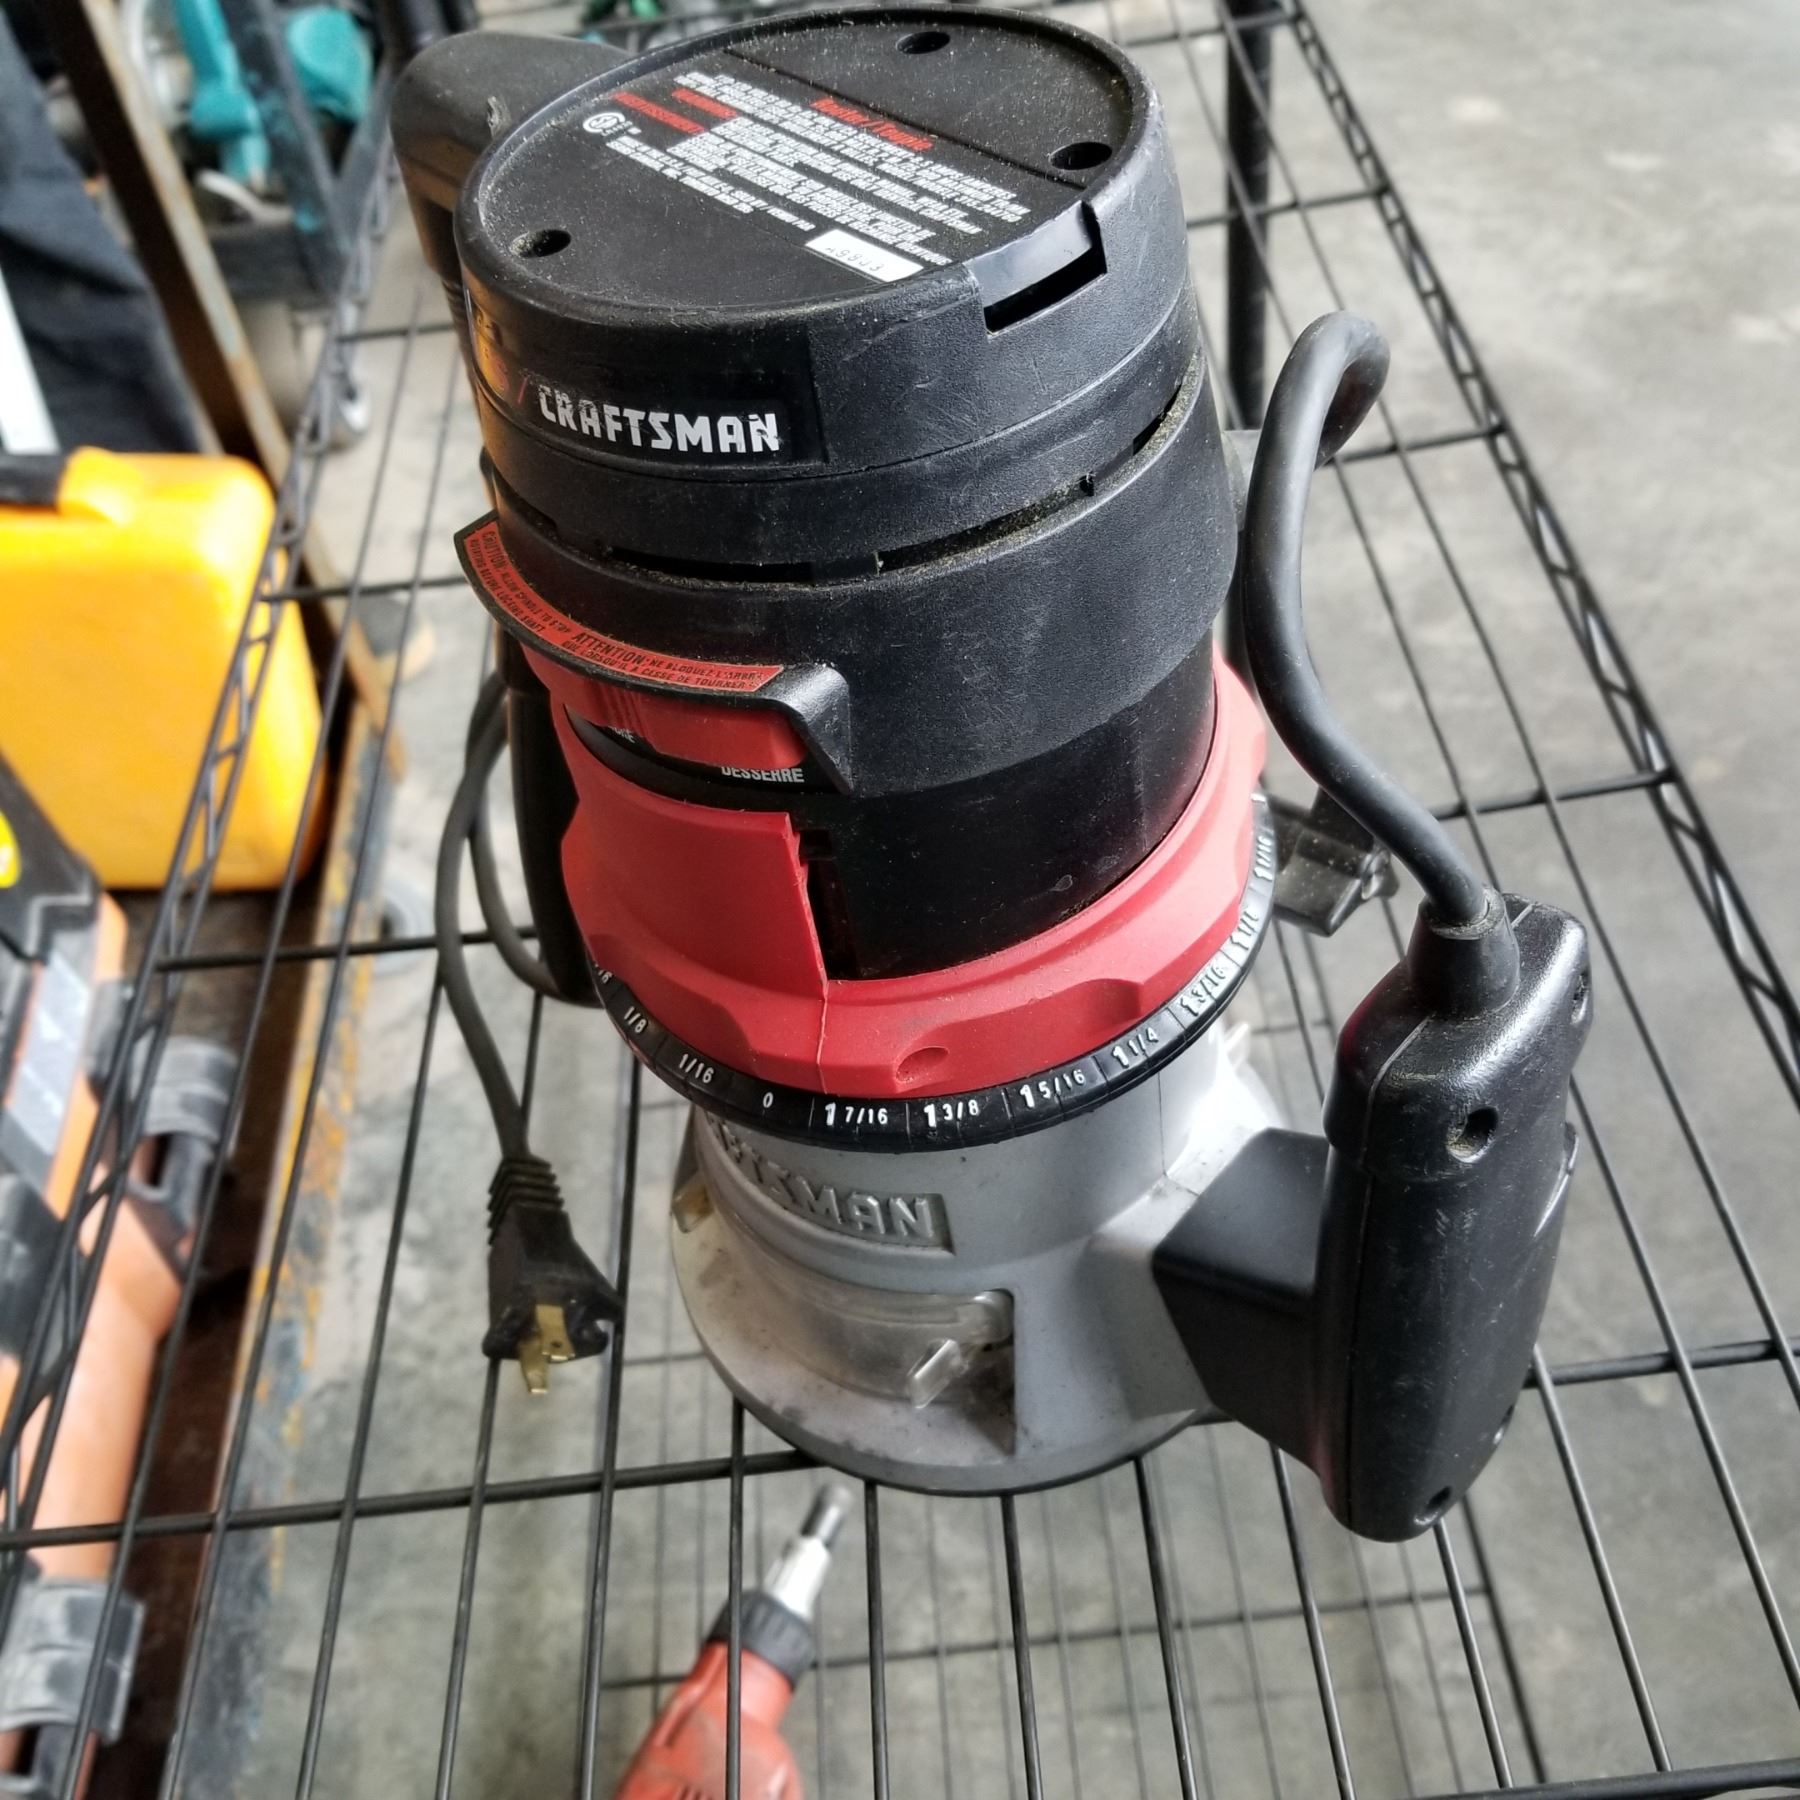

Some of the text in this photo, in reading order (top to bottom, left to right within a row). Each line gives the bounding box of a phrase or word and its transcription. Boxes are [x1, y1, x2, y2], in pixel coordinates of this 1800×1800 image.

[536, 384, 783, 453] CRAFTSMAN
[623, 1006, 648, 1034] 1/8
[677, 1053, 716, 1084] 1/16
[762, 1092, 775, 1109] 0
